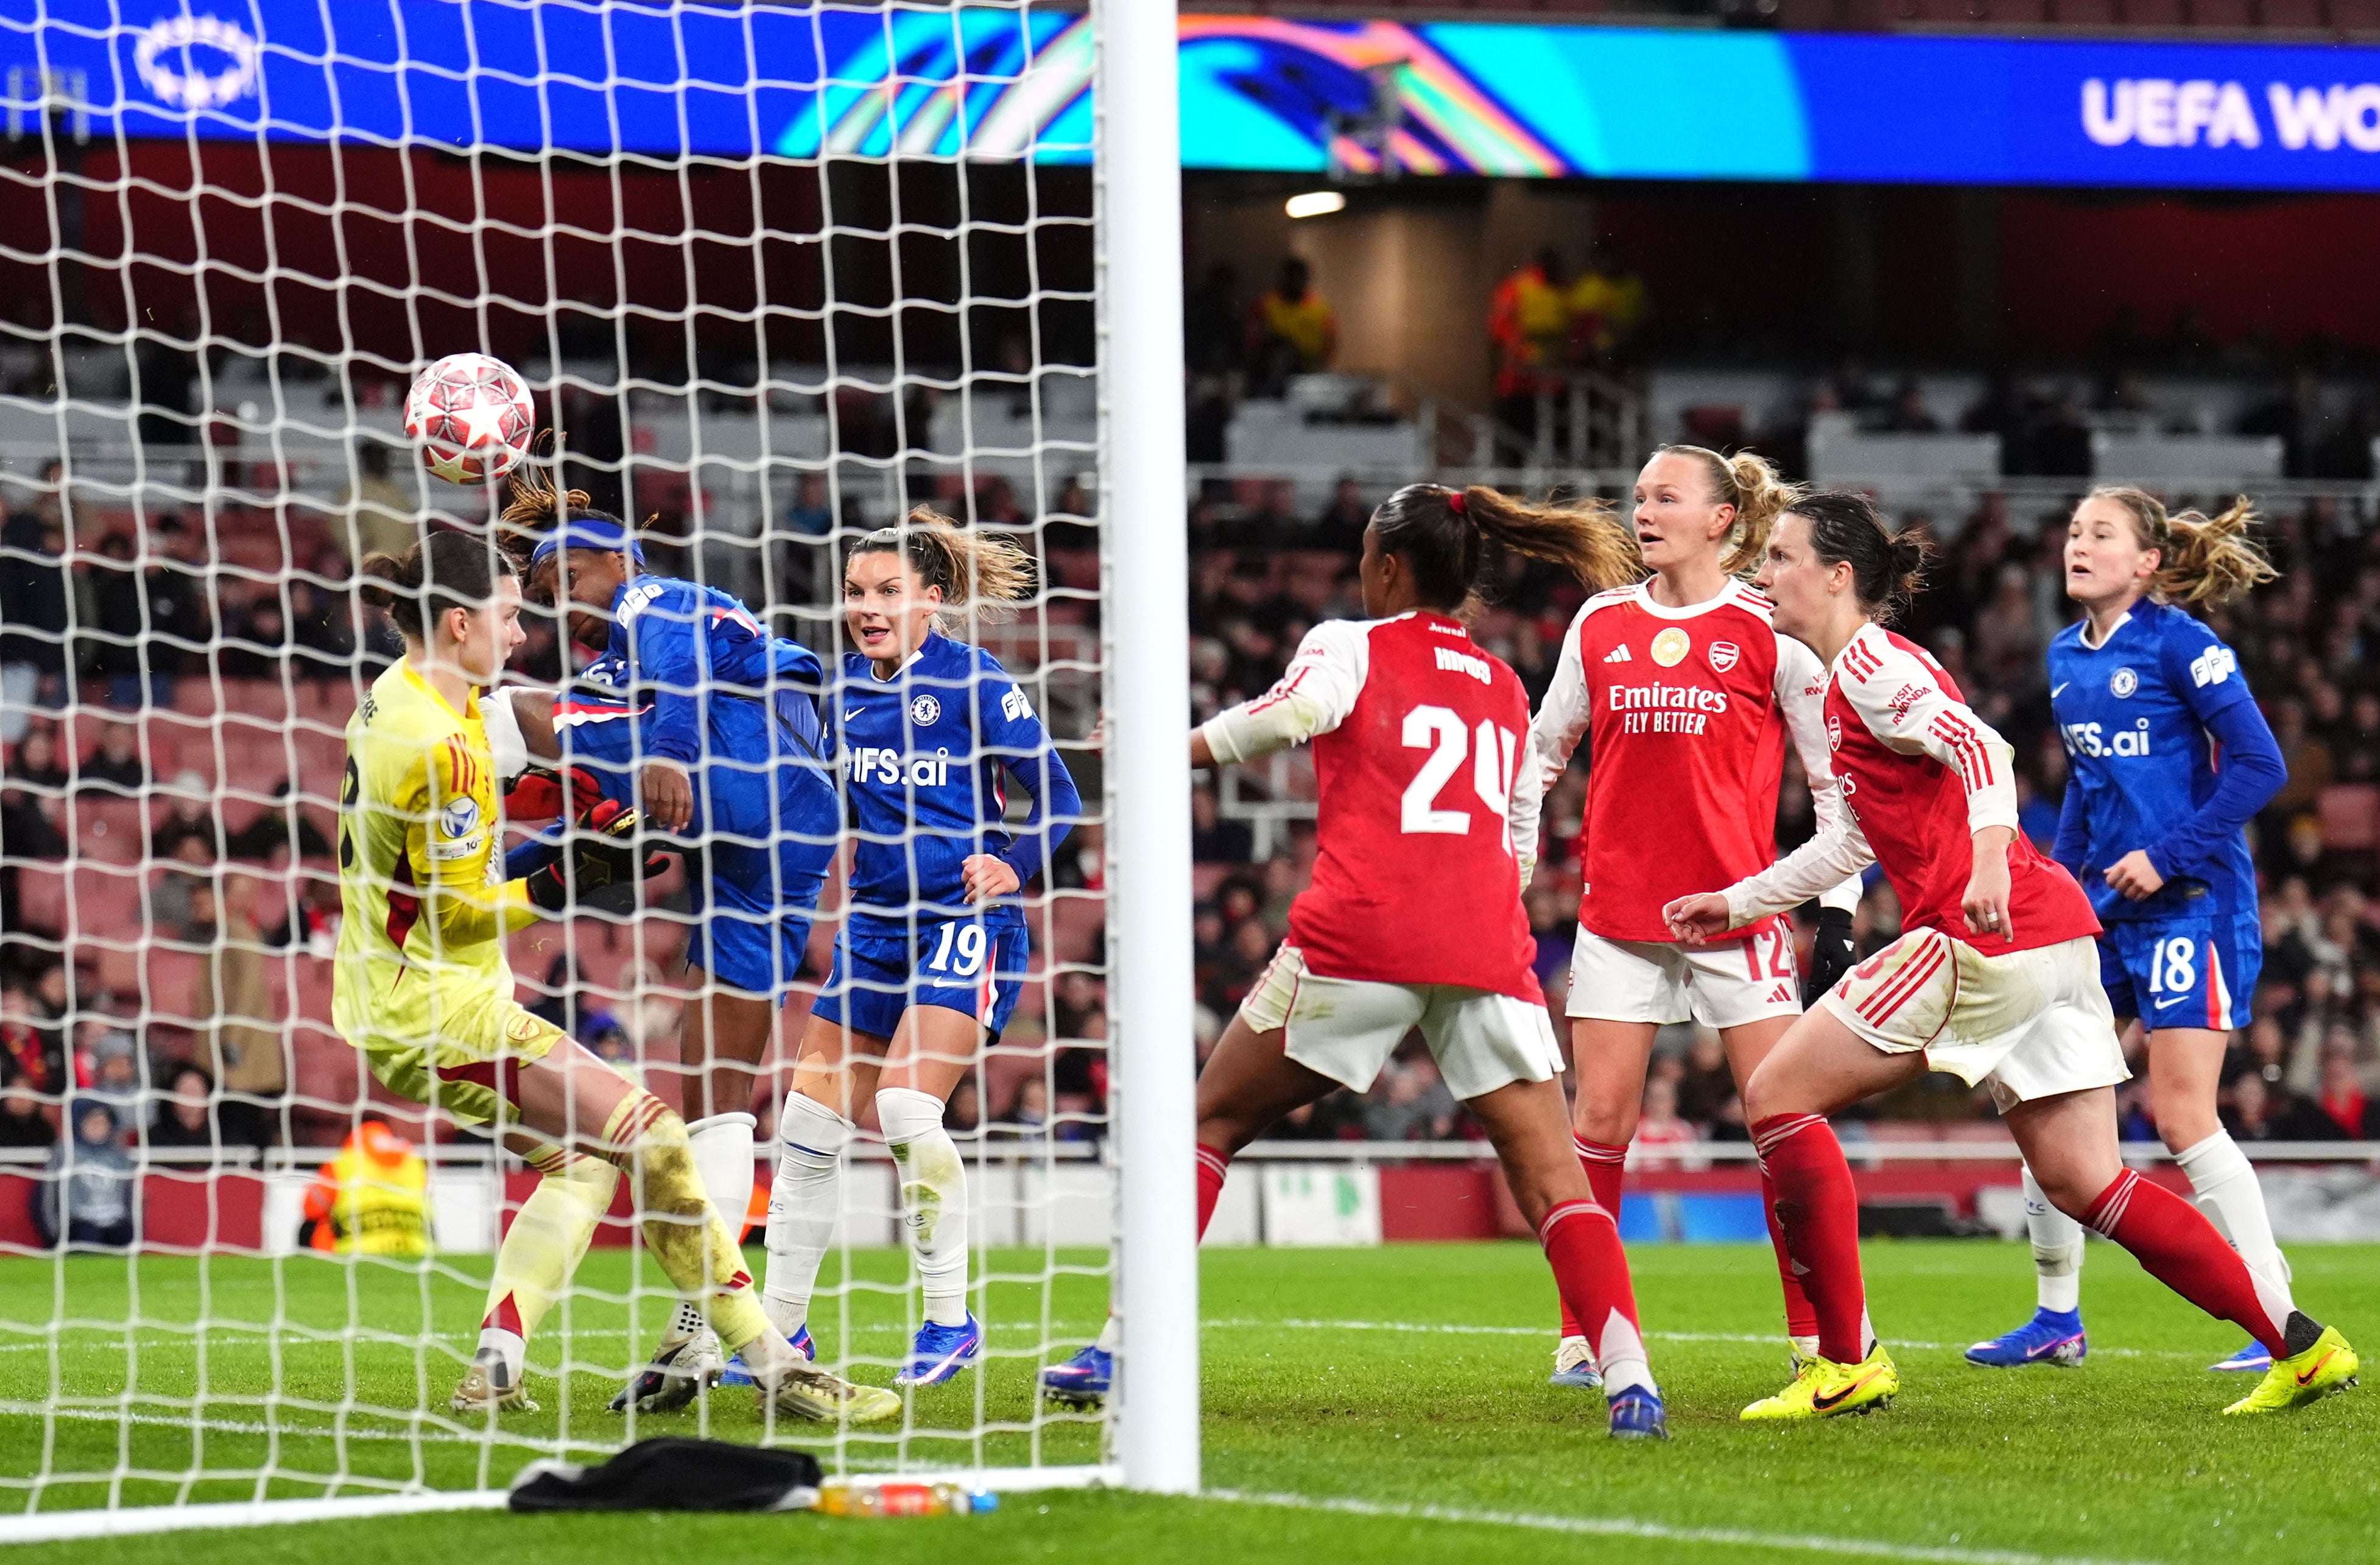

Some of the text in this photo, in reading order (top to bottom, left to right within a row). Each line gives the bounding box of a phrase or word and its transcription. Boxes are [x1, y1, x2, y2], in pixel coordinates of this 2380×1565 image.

[2082, 77, 2261, 148] UEFA
[1434, 646, 1491, 685] HINDS
[1609, 681, 1727, 713] Emirates
[1889, 683, 1913, 708] VISIT
[1892, 687, 1932, 726] RWANDA
[1625, 711, 1706, 735] FLY BETTER
[854, 747, 949, 786] IFS.ai
[1401, 704, 1516, 857] 24
[929, 921, 987, 976] 19
[2149, 937, 2195, 992] 18
